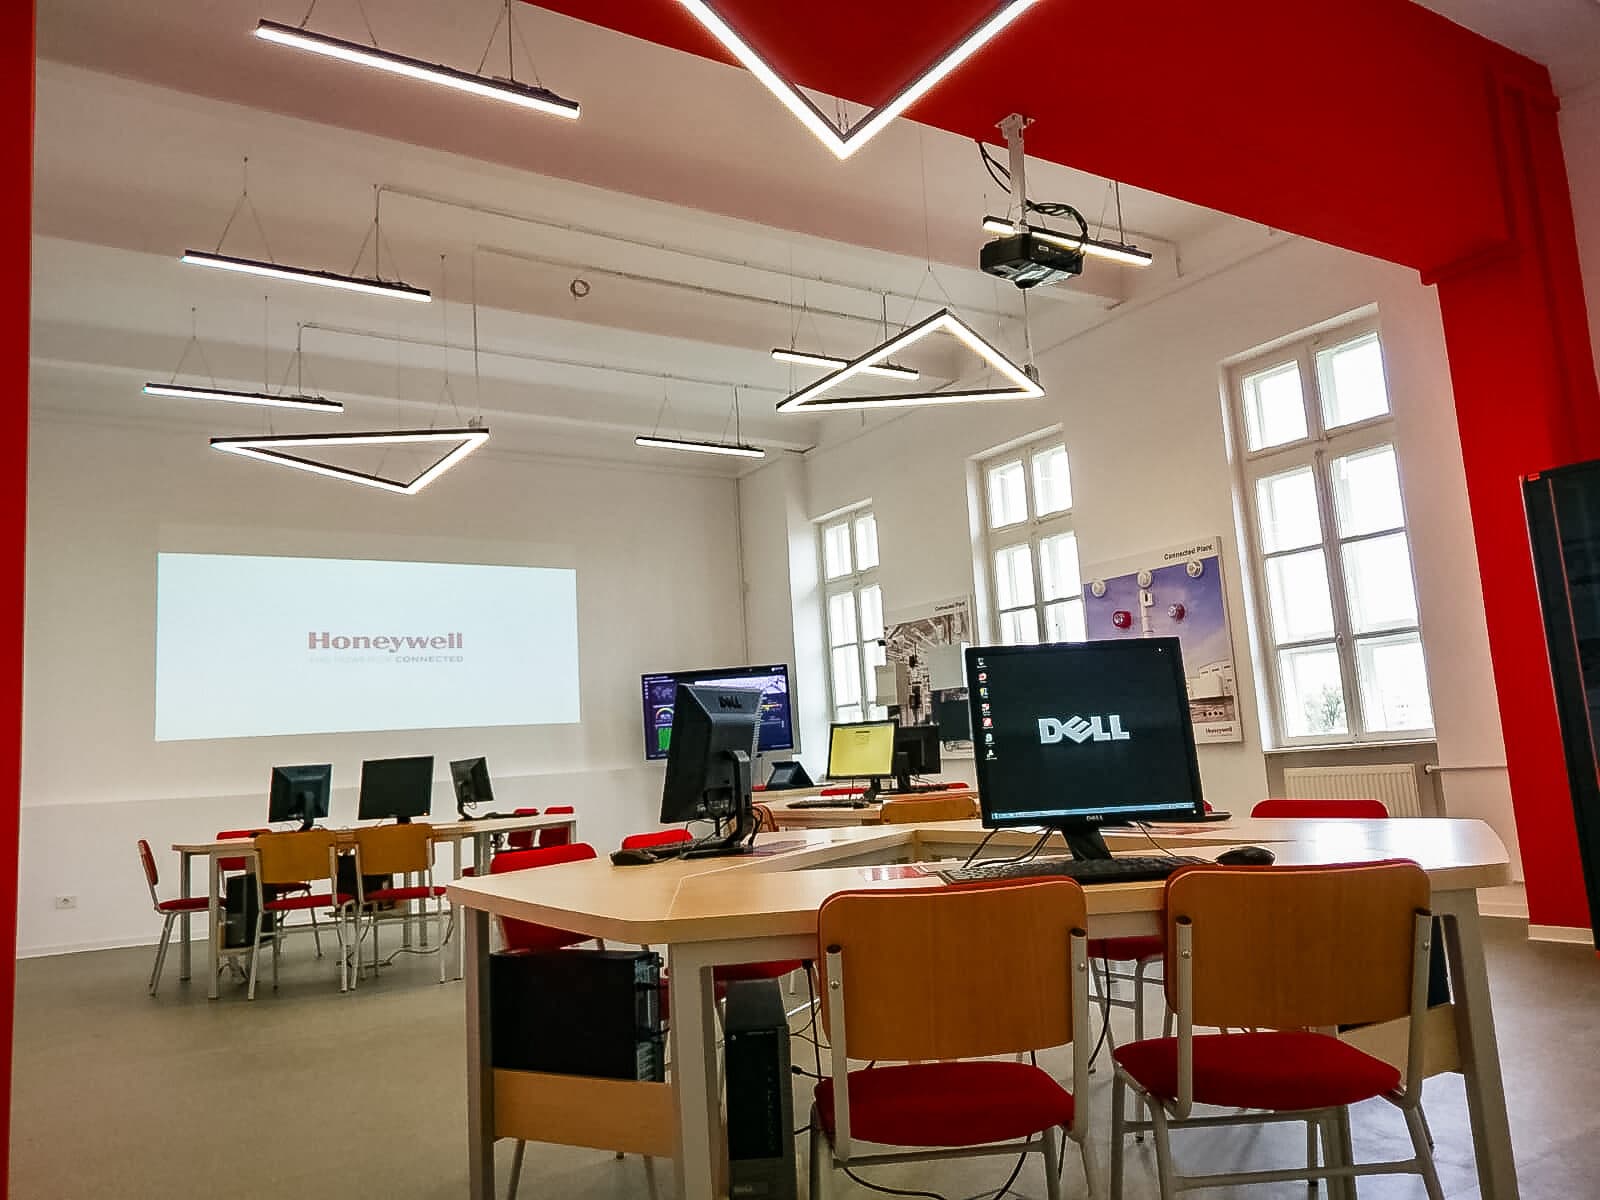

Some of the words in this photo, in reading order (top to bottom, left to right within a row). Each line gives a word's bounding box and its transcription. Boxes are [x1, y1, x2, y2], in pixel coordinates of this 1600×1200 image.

[1164, 547, 1196, 561] Connected
[1197, 543, 1214, 553] Plant
[308, 631, 463, 653] Honeywell
[395, 655, 464, 663] CONNECTED
[1037, 714, 1131, 745] DELL
